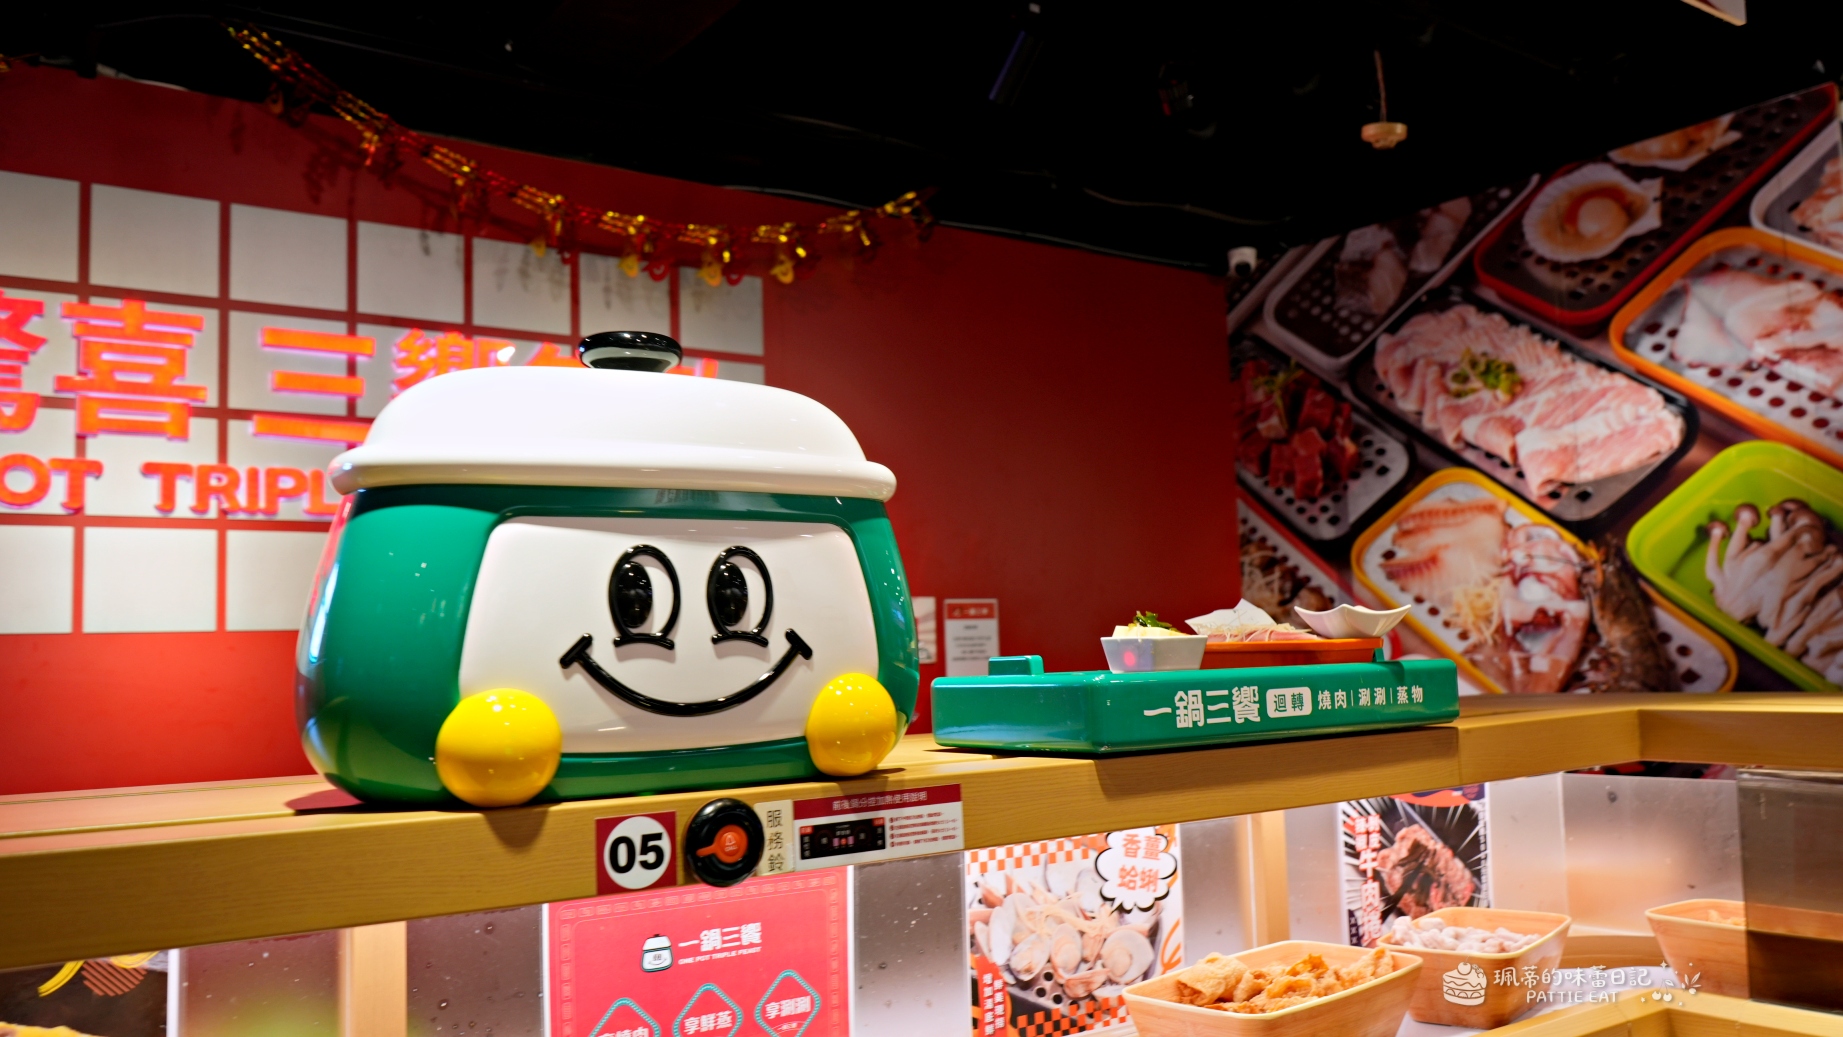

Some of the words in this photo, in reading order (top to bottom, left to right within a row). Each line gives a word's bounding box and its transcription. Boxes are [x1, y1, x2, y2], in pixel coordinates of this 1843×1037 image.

[0, 453, 104, 514] OT
[140, 461, 345, 516] TRIPL
[1143, 686, 1261, 729] 一鍋三饗
[1273, 692, 1305, 713] 迴轉
[1317, 689, 1347, 710] 燒肉
[1358, 687, 1386, 706] 涮涮
[1396, 685, 1424, 704] 蒸物
[608, 832, 665, 874] 05
[766, 809, 784, 873] 服務鈴
[678, 922, 762, 951] 一鍋三饗
